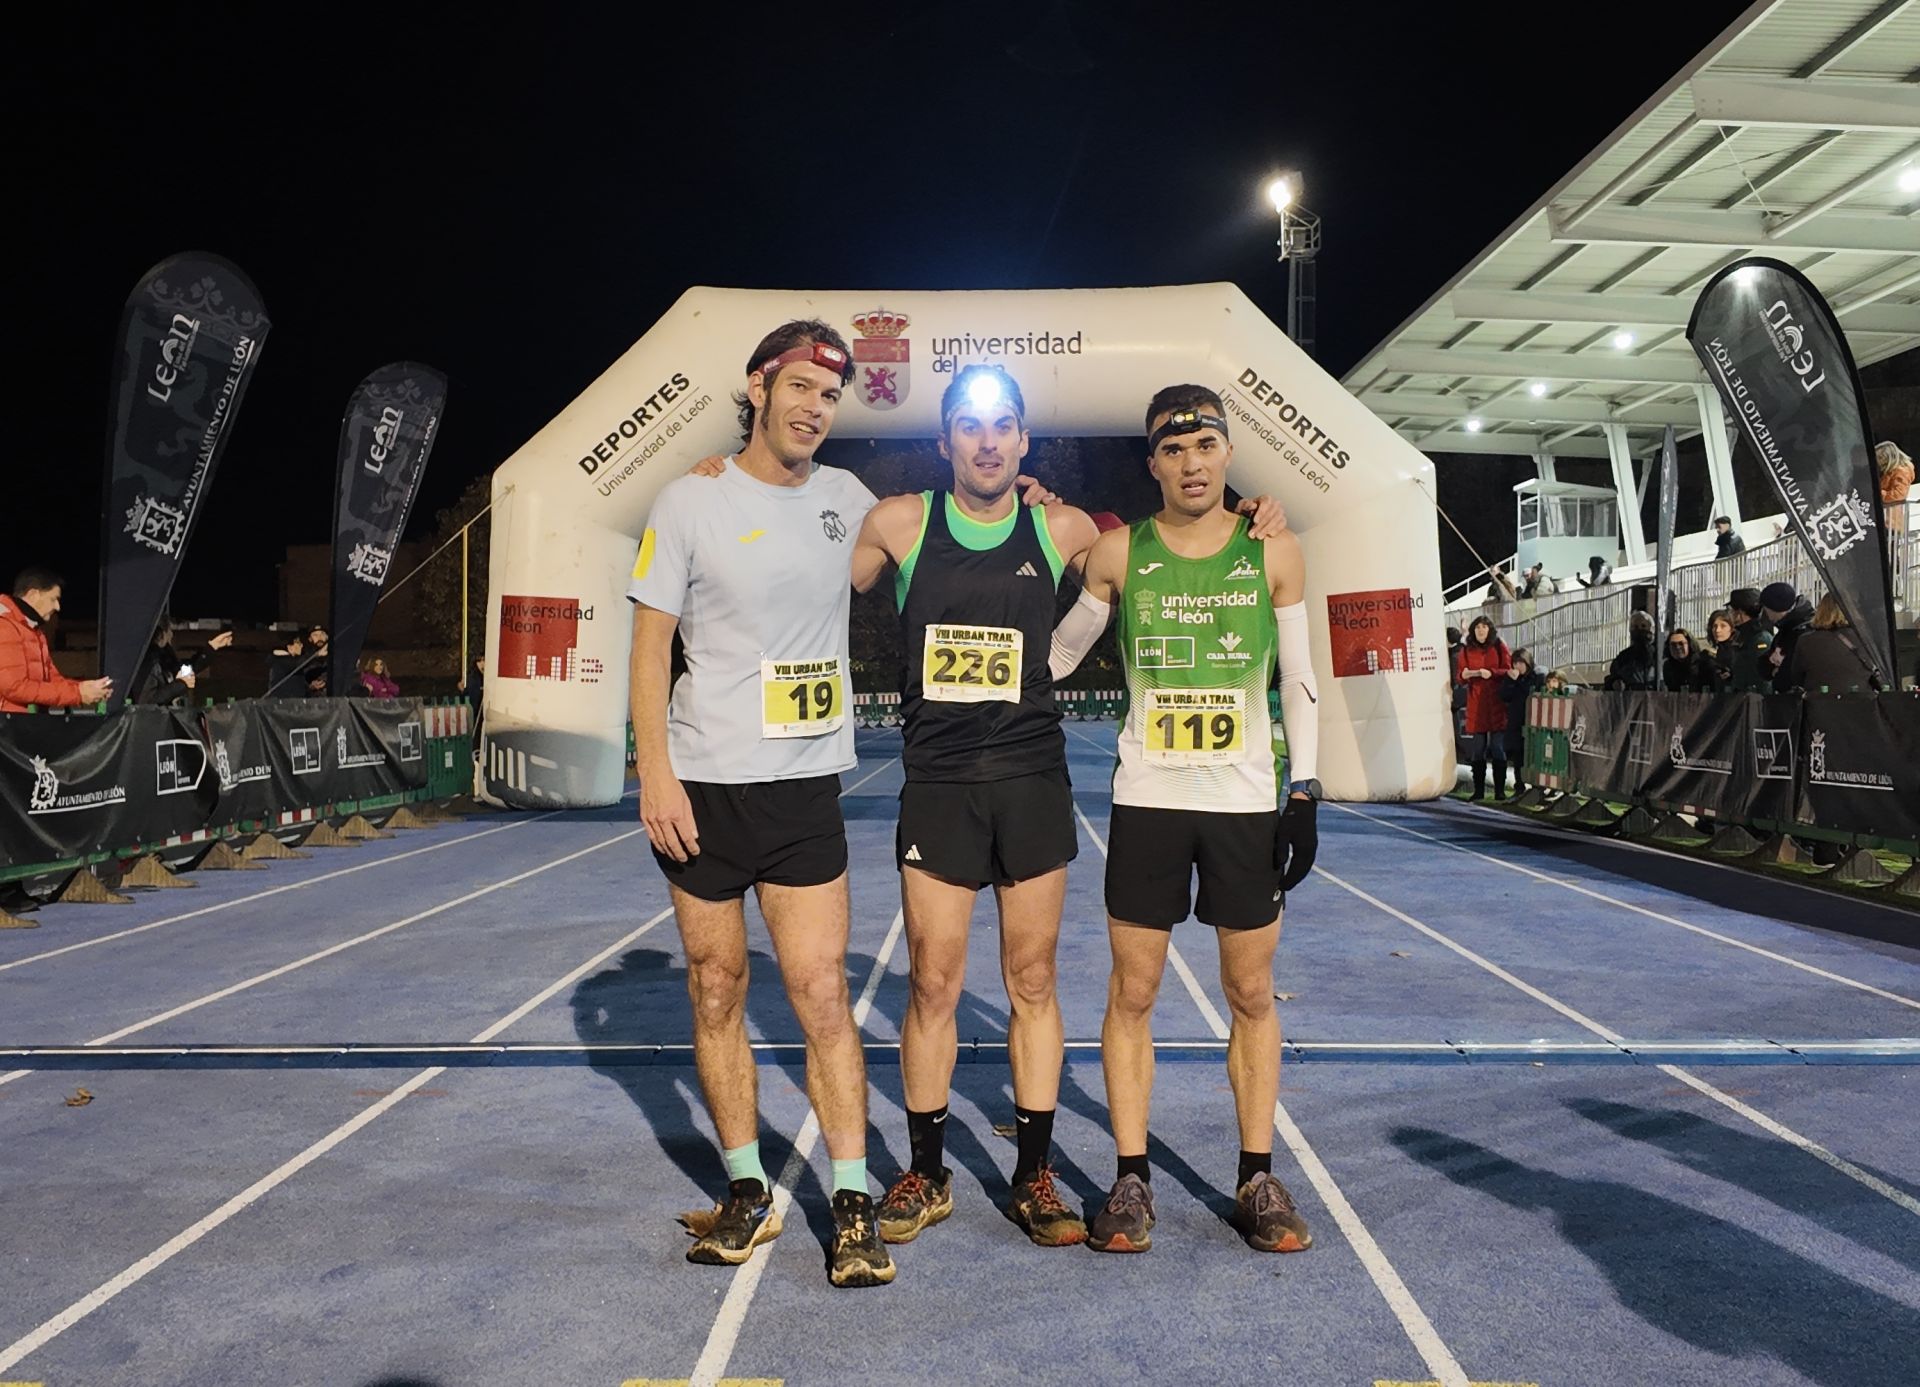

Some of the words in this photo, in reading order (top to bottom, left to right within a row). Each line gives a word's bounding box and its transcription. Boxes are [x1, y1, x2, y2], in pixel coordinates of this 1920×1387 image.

[229, 335, 251, 373] LEÓN
[932, 331, 1081, 355] universidad
[222, 374, 238, 396] DE
[578, 372, 690, 476] DEPORTES
[1237, 367, 1350, 470] DEPORTES
[183, 398, 228, 510] AYUNTAMIENTO
[597, 434, 667, 497] Universidad
[665, 421, 682, 438] de
[679, 394, 713, 424] León
[1282, 446, 1300, 466] de
[1299, 462, 1330, 494] León
[1161, 590, 1258, 608] universidad
[1329, 593, 1424, 617] universidad
[501, 602, 594, 621] universidad
[1161, 607, 1177, 619] de
[1178, 609, 1214, 624] león
[952, 630, 985, 641] URBAN
[986, 632, 1013, 643] TRAIL
[1140, 645, 1162, 657] LEÓN
[793, 663, 823, 675] URBAN
[932, 648, 1010, 686] 226
[788, 681, 833, 721] 19
[1173, 694, 1207, 704] URBAN
[1208, 694, 1236, 704] TRAIL
[1155, 713, 1235, 750] 119
